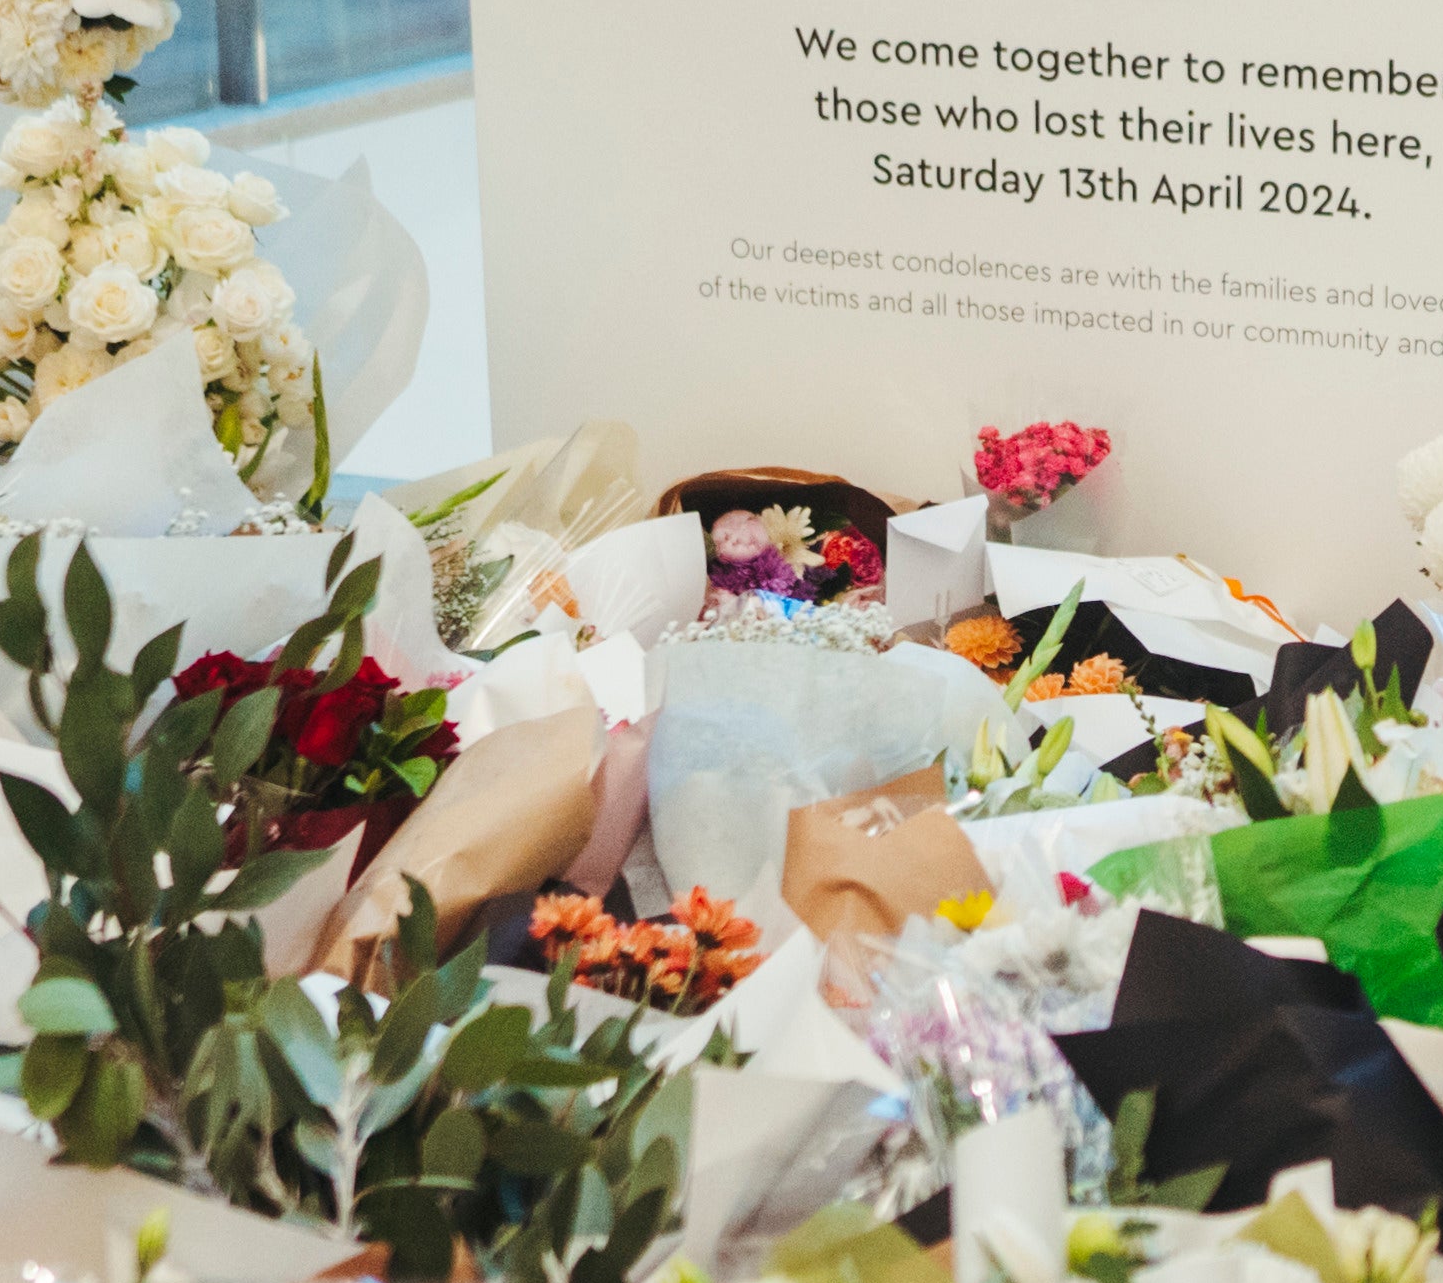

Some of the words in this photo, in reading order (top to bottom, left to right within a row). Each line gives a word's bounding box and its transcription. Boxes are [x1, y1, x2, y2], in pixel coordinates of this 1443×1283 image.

[792, 24, 859, 64] We
[869, 37, 981, 71] come
[991, 38, 1172, 84] together
[1181, 50, 1228, 86] to
[812, 84, 924, 129] those
[932, 93, 1021, 135] who
[1032, 97, 1107, 141] lost
[1117, 104, 1215, 147] their
[1226, 110, 1317, 155] lives
[1330, 116, 1434, 171] here,
[871, 151, 1046, 206] Saturday
[1057, 164, 1140, 205] 13th
[1149, 172, 1245, 217] April
[1257, 178, 1373, 222] 2024.
[729, 236, 774, 261] Our
[782, 240, 883, 270] deepest
[891, 252, 1052, 284] condolences
[1059, 267, 1100, 287] are
[1107, 266, 1162, 291] with
[1170, 269, 1213, 296] the
[1220, 271, 1317, 304] families
[1325, 284, 1375, 308] and
[697, 274, 722, 299] of
[727, 277, 768, 303] the
[774, 286, 860, 310] victims
[867, 291, 914, 314] and
[921, 293, 948, 316] all
[955, 295, 1026, 324] those
[1033, 302, 1154, 334] impacted
[1163, 312, 1184, 335] in
[1192, 320, 1235, 340] our
[1242, 324, 1389, 358] community
